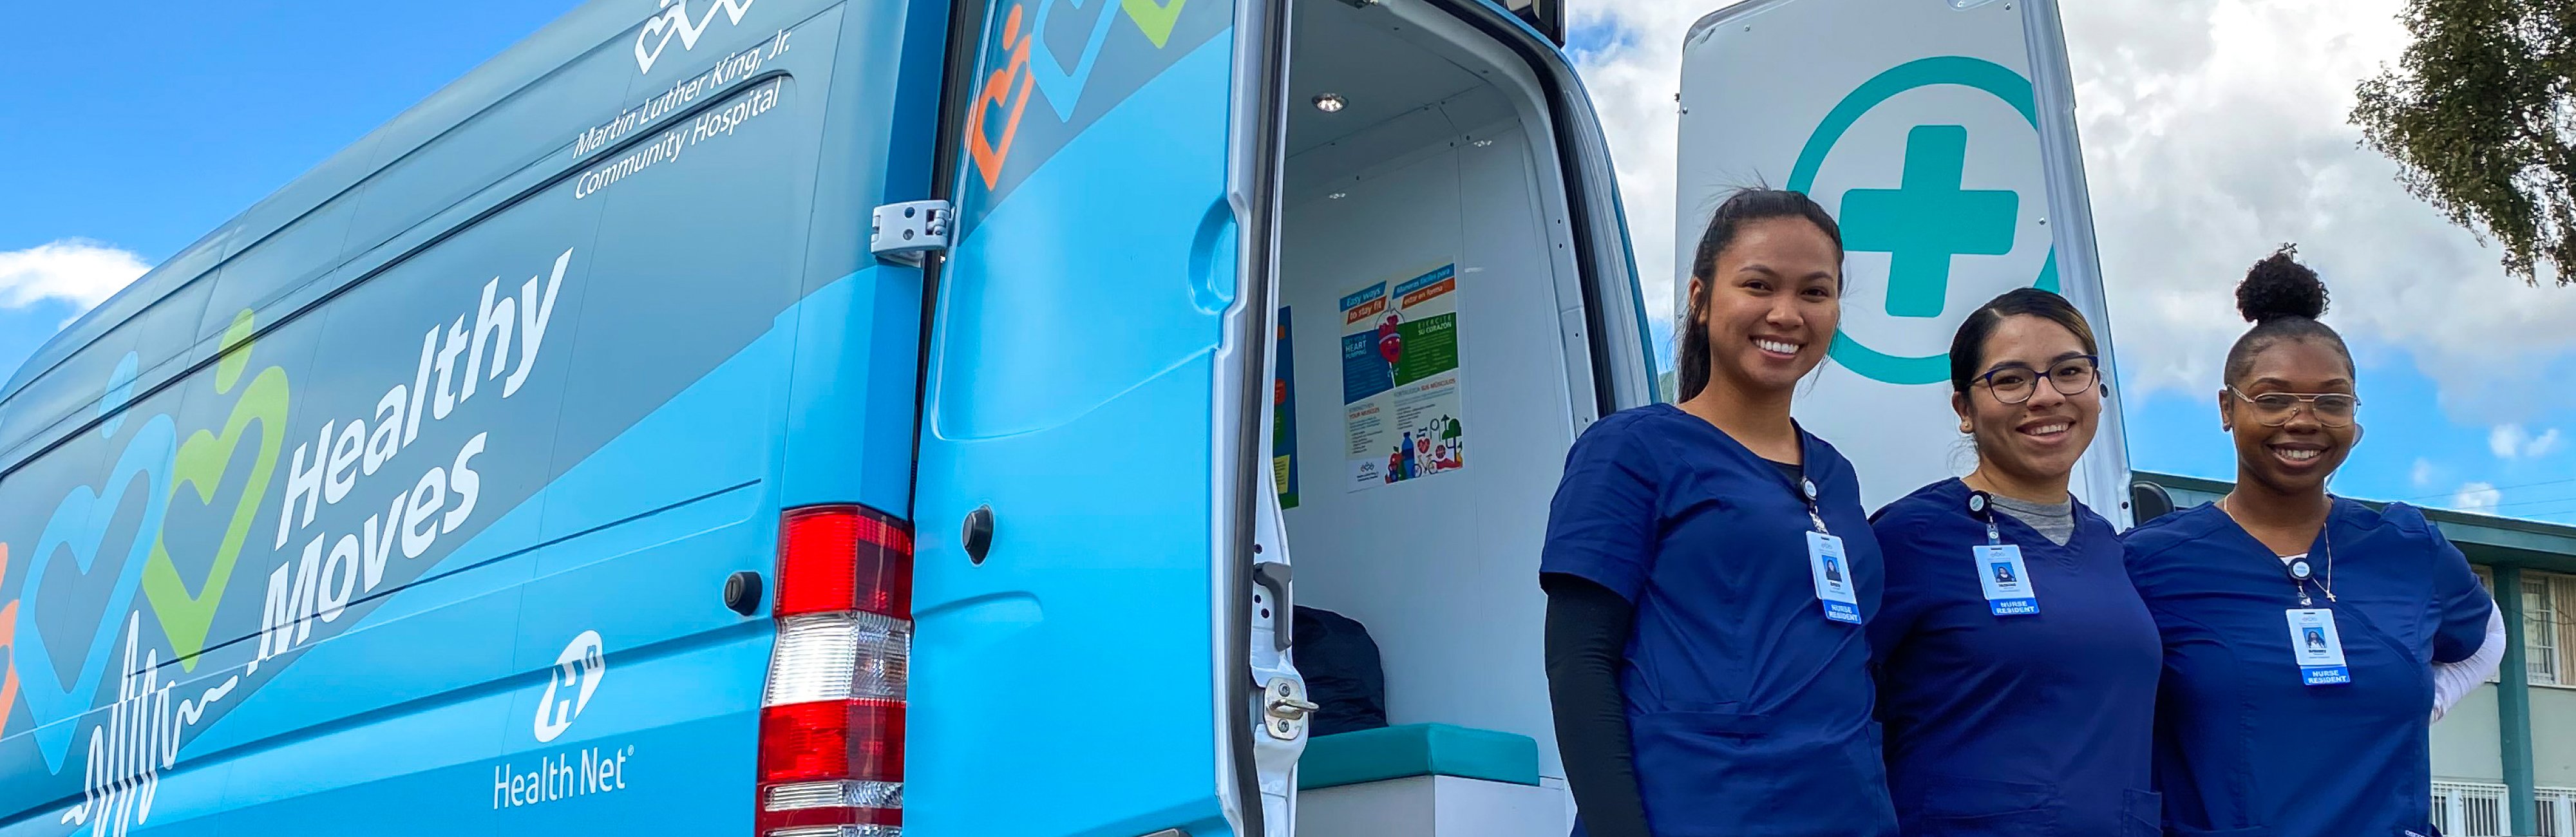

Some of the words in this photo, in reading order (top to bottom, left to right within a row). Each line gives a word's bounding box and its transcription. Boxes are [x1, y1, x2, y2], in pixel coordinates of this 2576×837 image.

[573, 109, 637, 159] Martin
[639, 75, 708, 126] Luther
[710, 48, 762, 89] King,
[768, 29, 792, 61] Jr.
[576, 129, 689, 199] Community
[691, 76, 782, 146] Hospital
[1347, 294, 1362, 307] Easy
[1363, 287, 1381, 299] ways
[1350, 310, 1358, 320] to
[1358, 305, 1372, 316] stay
[1373, 300, 1382, 310] fit
[1345, 339, 1367, 353] HEART
[275, 247, 574, 551] Healthy
[247, 431, 488, 677] Moves
[1828, 610, 1859, 623] RESIDENT
[1830, 603, 1852, 614] NURSE
[1996, 606, 2035, 614] RESIDENT
[2307, 675, 2347, 684] RESIDENT
[2312, 669, 2340, 677] NURSE
[493, 752, 574, 810] Health
